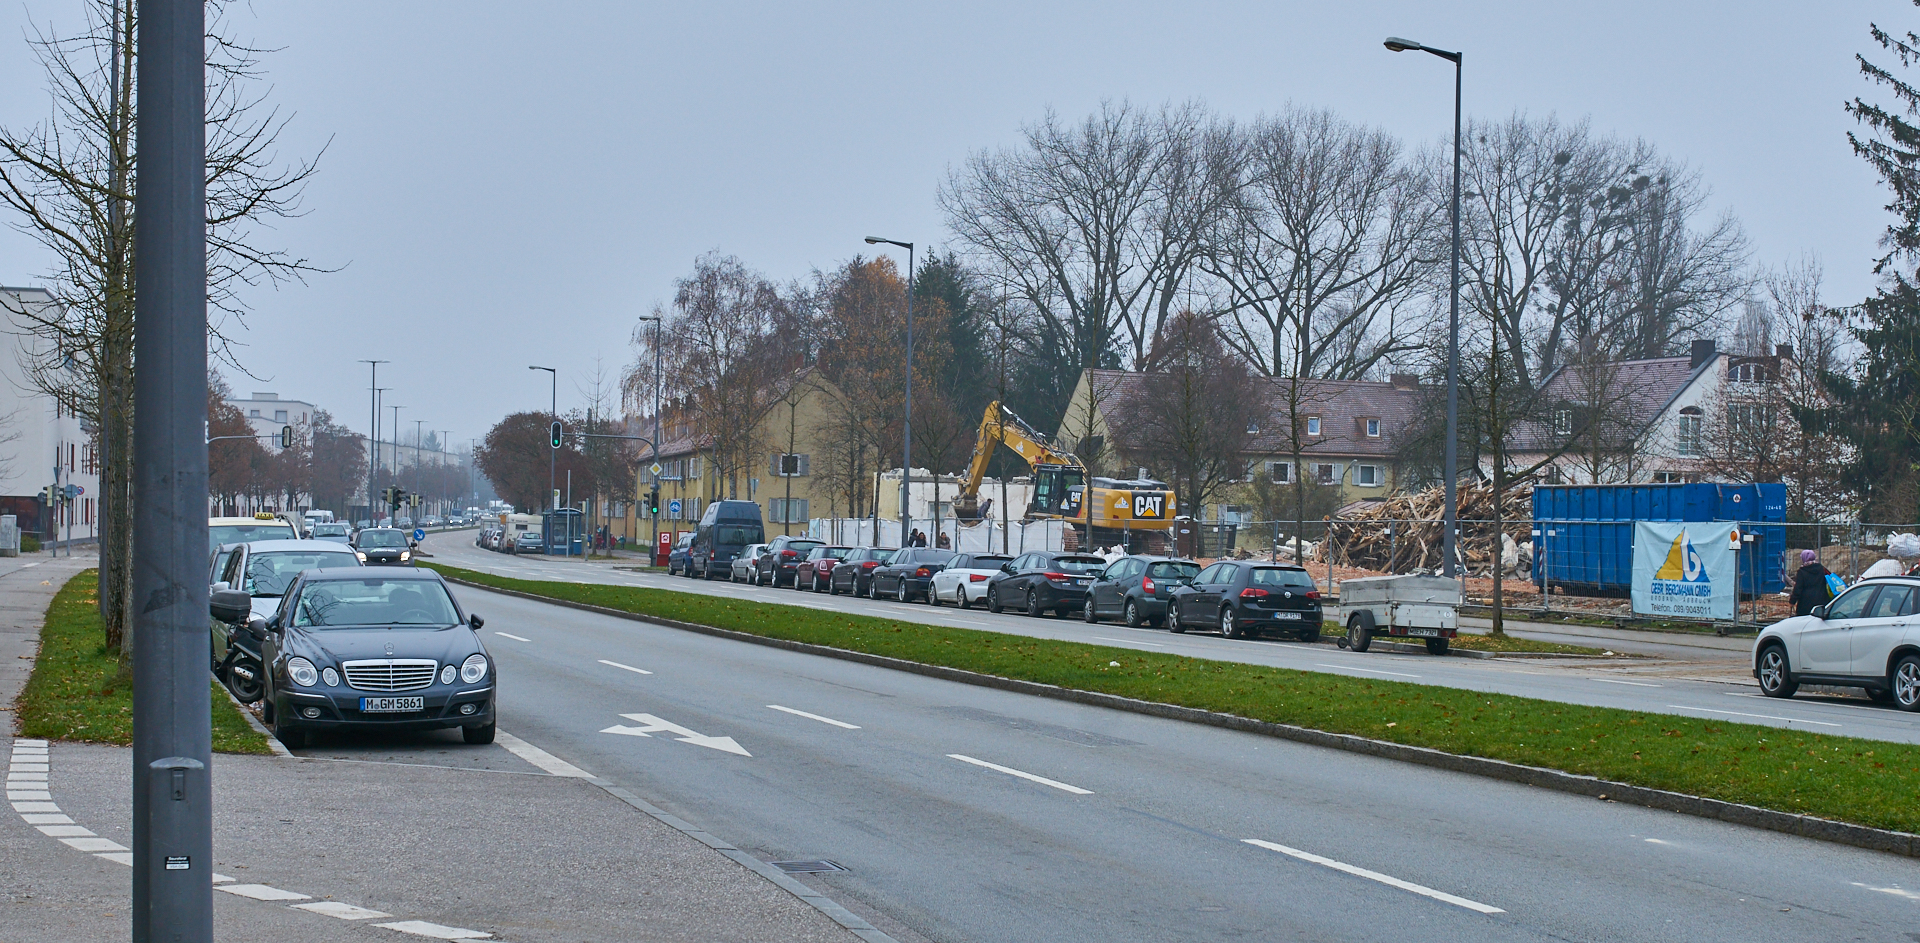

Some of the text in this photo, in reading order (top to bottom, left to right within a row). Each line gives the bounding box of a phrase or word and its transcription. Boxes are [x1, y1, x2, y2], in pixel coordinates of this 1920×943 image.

[1071, 492, 1081, 502] CAT
[1135, 496, 1162, 517] CAT
[1651, 582, 1664, 595] GEBR.
[1665, 583, 1694, 597] BERGMANN
[366, 698, 422, 709] M GM 5861
